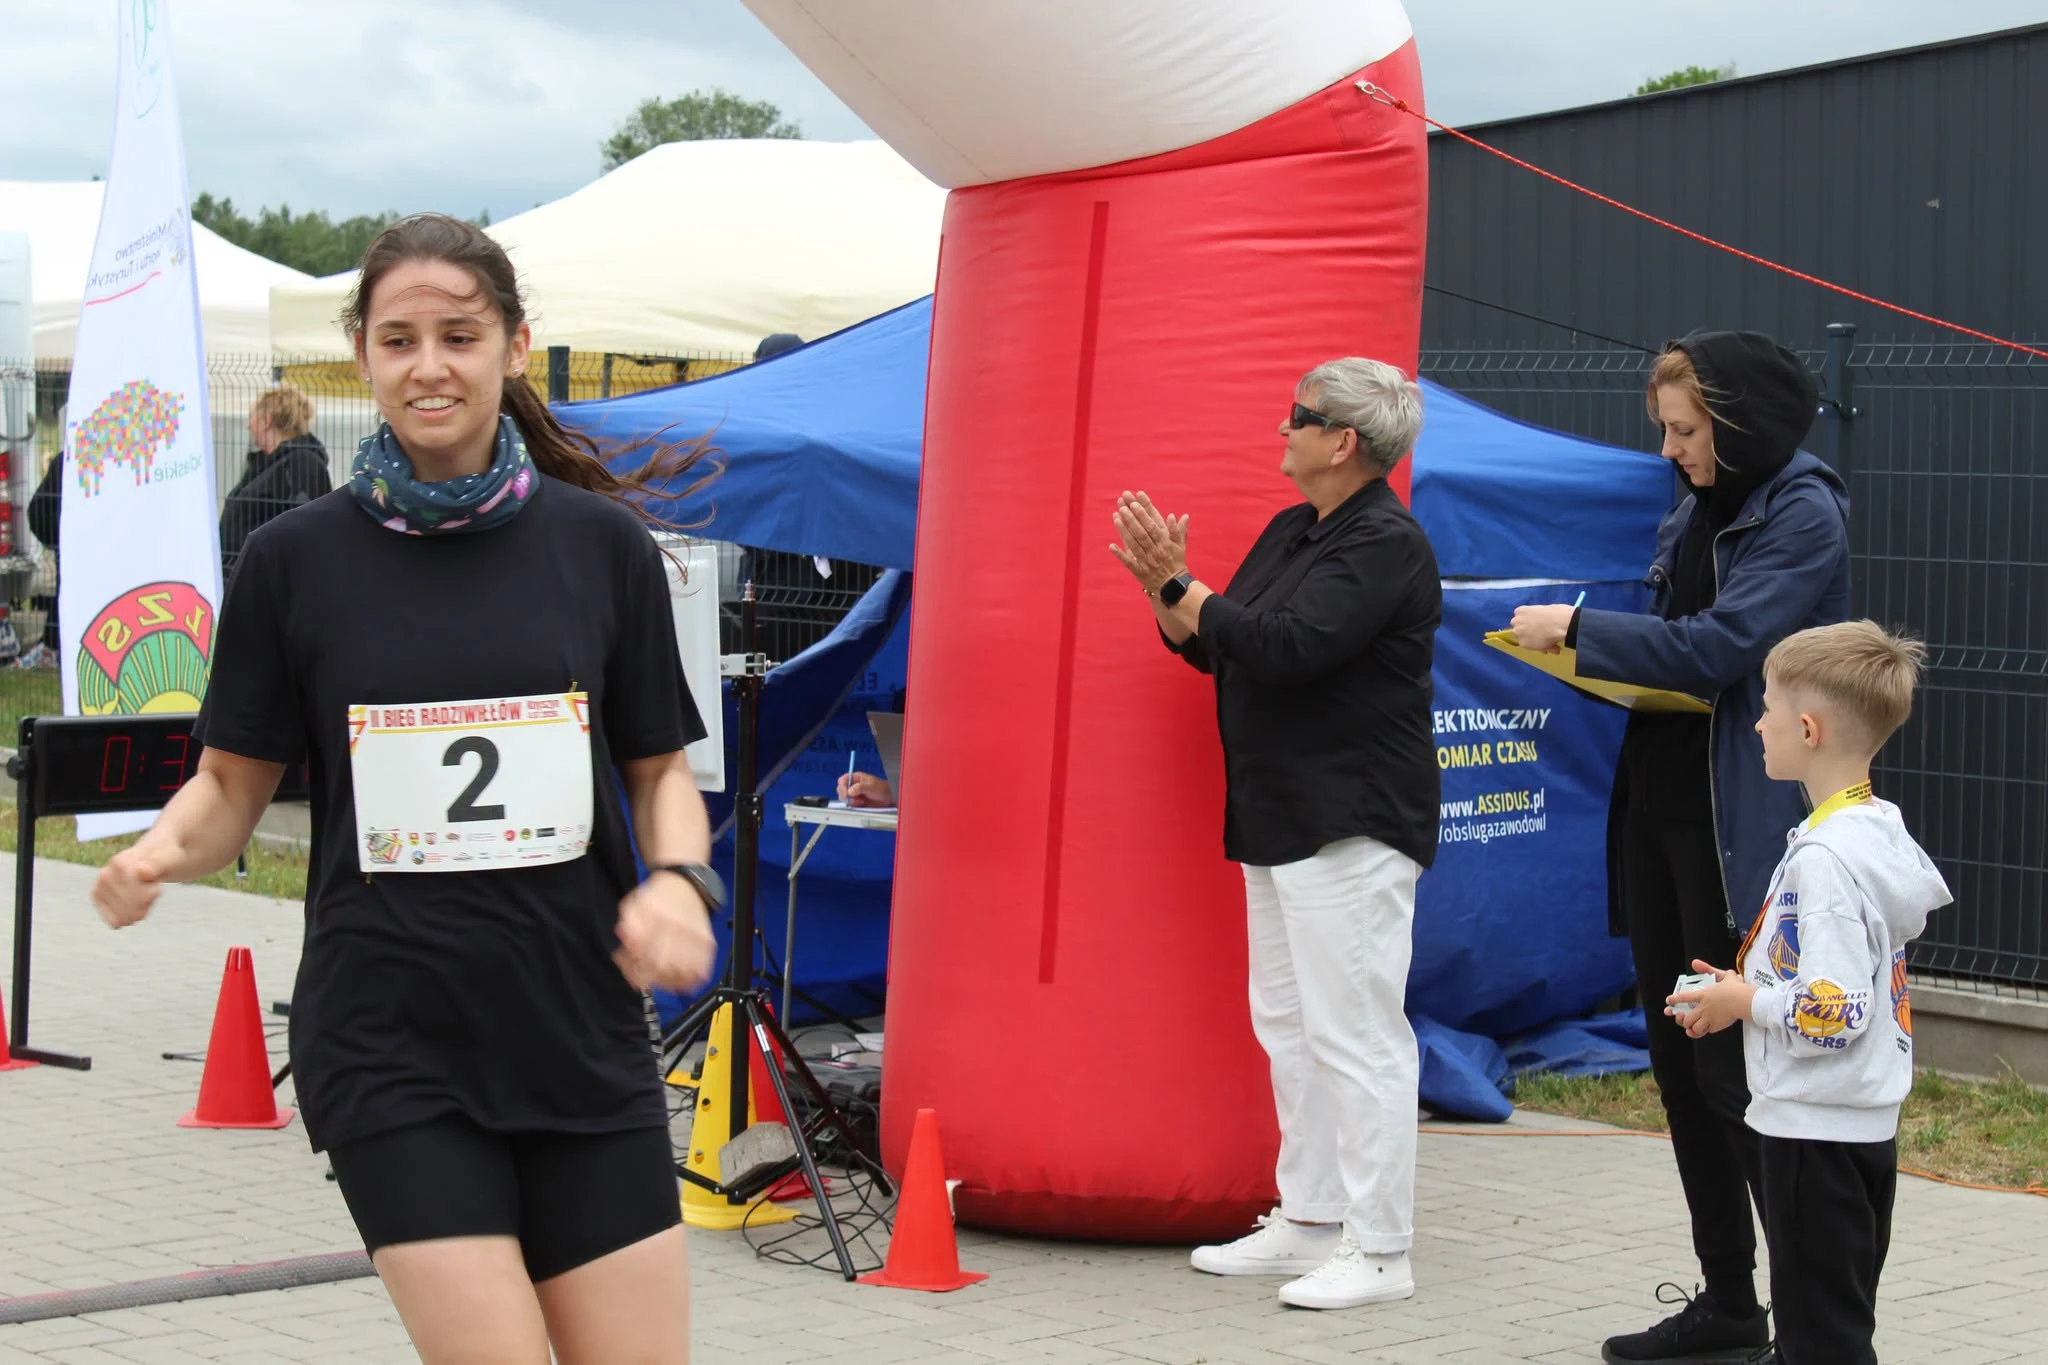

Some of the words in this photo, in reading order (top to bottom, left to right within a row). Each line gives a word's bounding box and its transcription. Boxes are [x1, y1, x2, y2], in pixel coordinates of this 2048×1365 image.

[384, 708, 416, 727] BIEG
[421, 699, 522, 726] RADZIWIŁŁÓW
[1437, 743, 1493, 769] OMIAR
[1496, 741, 1538, 764] CZASU
[441, 735, 506, 823] 2
[1439, 787, 1545, 819] www.ASSIDUS.pl
